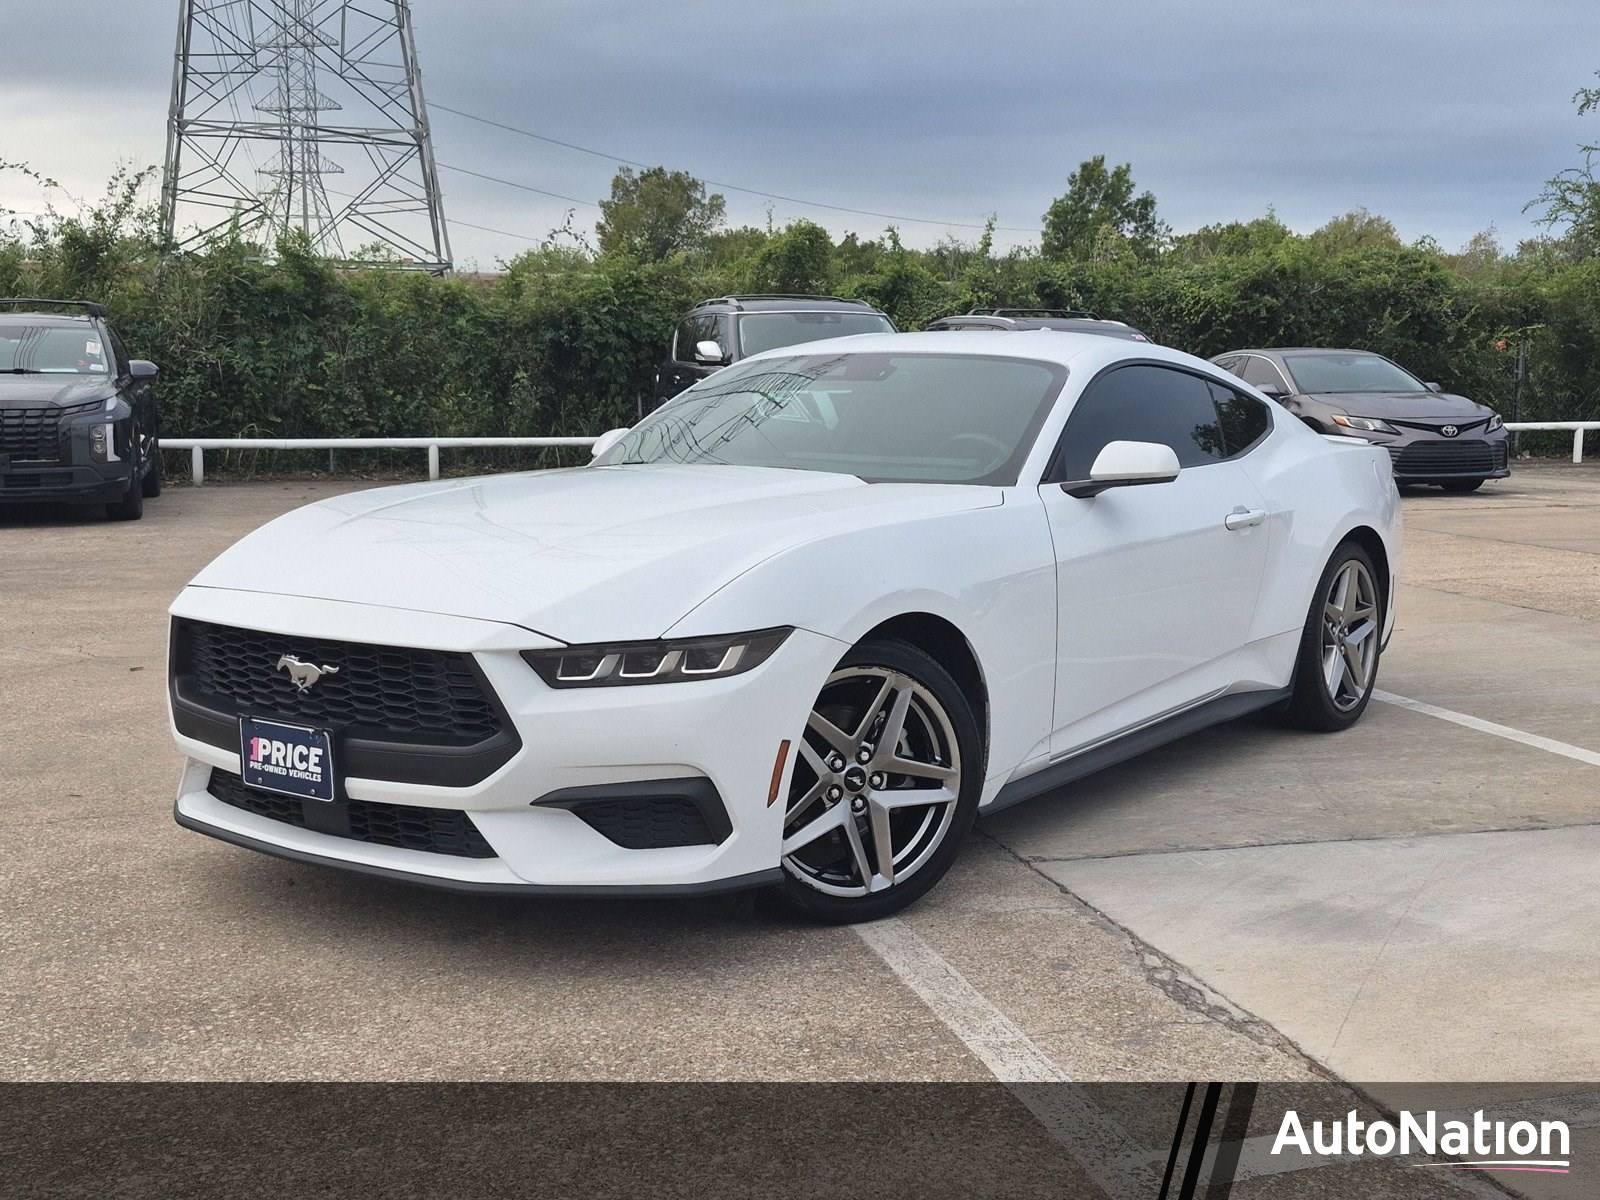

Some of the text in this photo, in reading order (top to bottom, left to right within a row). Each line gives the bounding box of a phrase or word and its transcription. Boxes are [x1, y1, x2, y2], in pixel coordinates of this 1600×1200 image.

[250, 737, 323, 773] 1PRICE
[250, 761, 322, 782] PRE-OWNED VEHICLES
